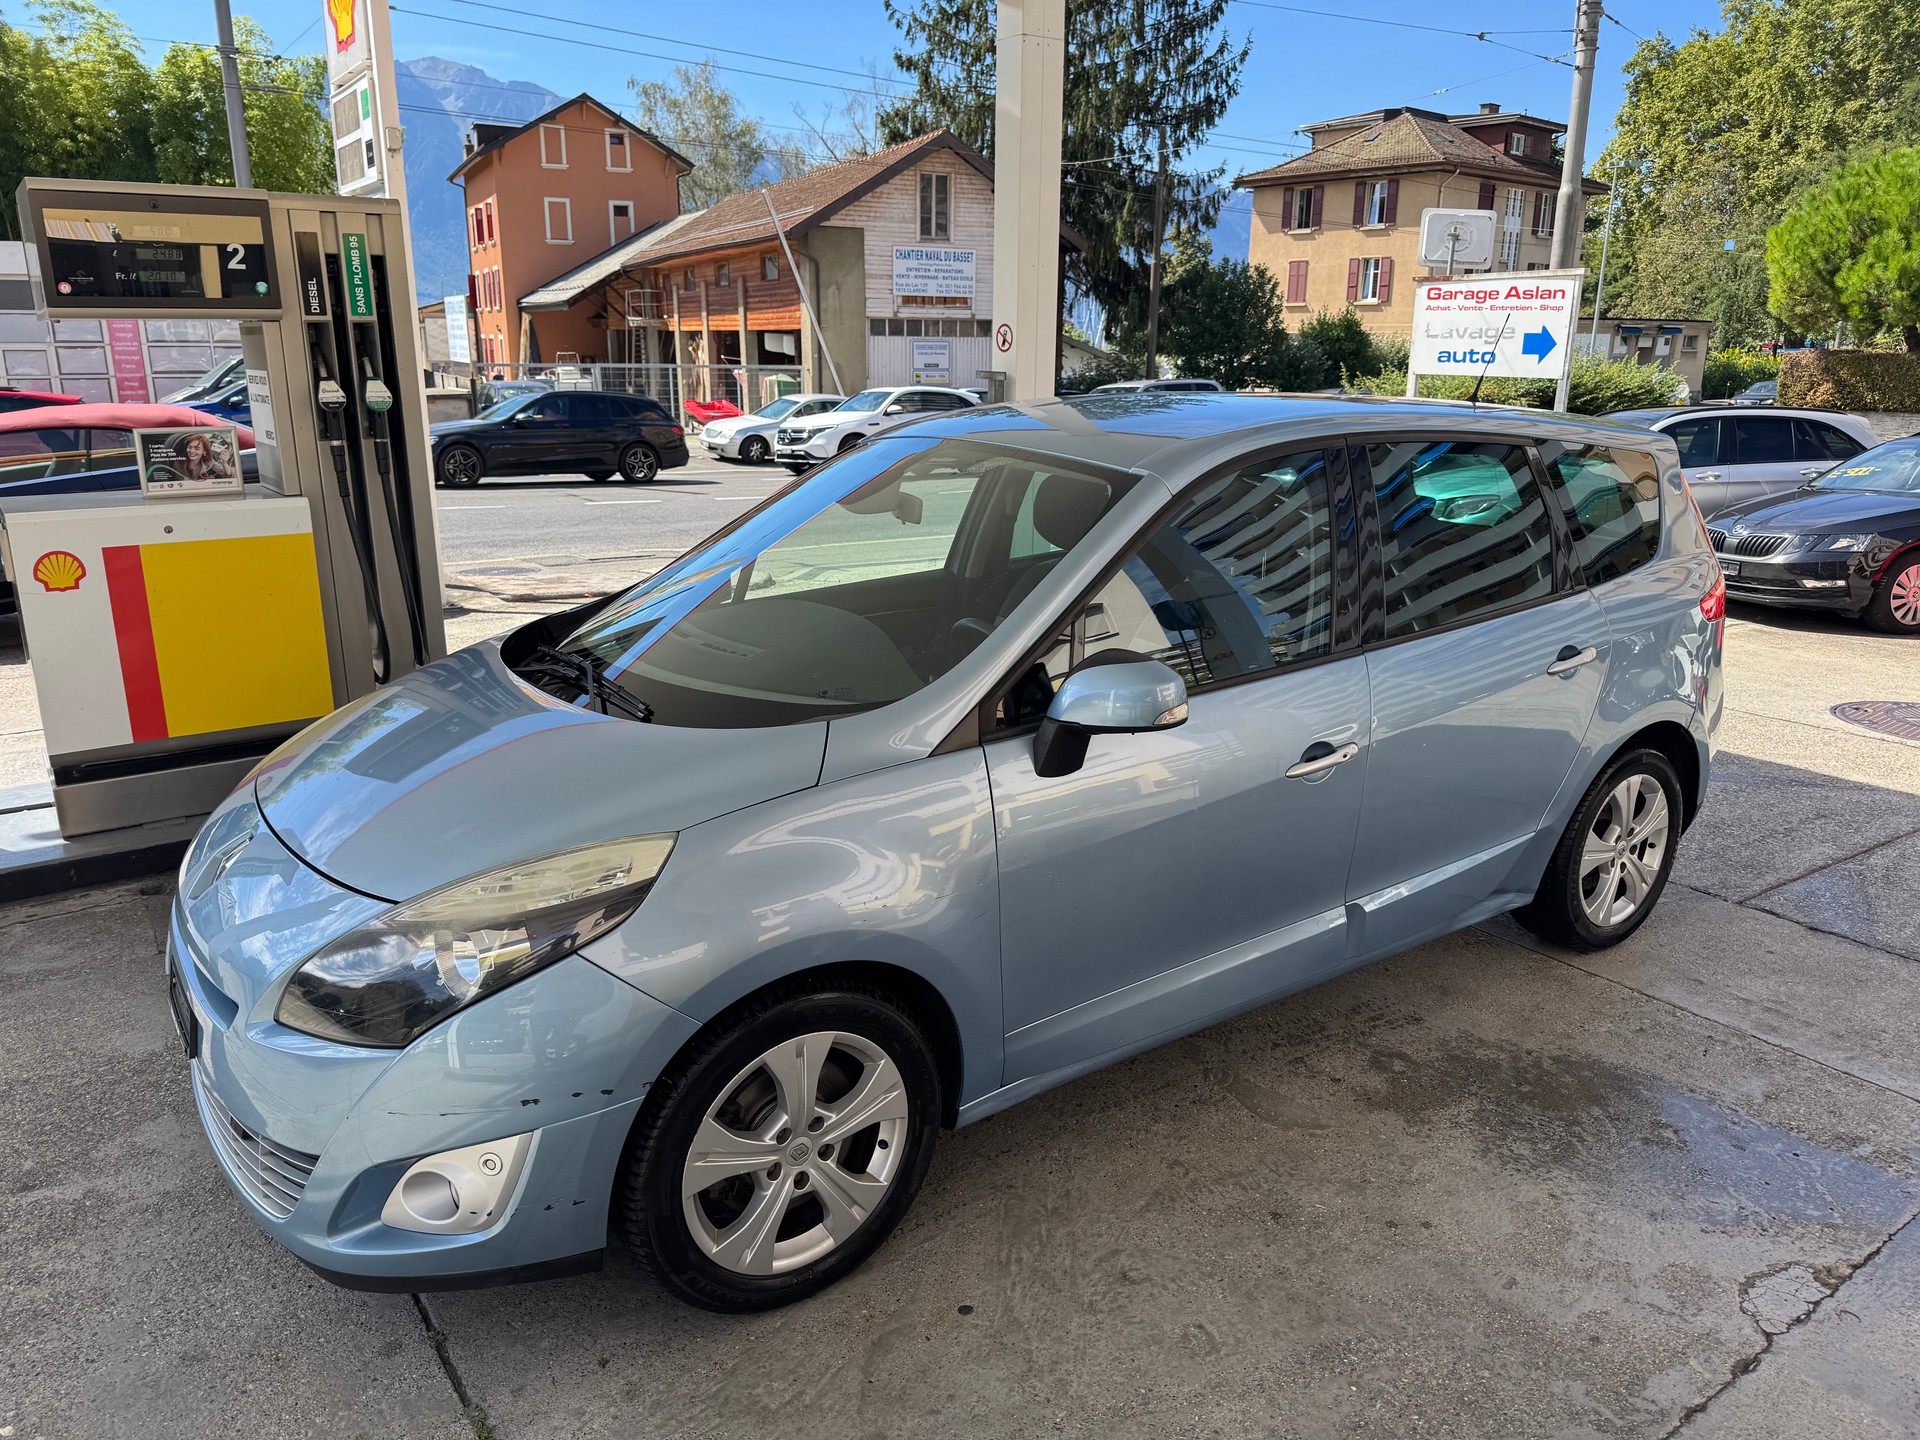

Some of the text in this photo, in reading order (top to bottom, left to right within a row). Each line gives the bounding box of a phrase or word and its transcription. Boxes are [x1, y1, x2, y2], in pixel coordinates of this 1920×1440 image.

[226, 243, 247, 270] 2
[895, 249, 974, 263] CHANTIER NAVAL DU BASSET
[115, 272, 128, 280] Fr.
[349, 236, 366, 313] SANS PLOMB 95
[308, 277, 320, 313] DIESEL
[1427, 286, 1566, 304] Garage Aslan
[1425, 304, 1452, 312] Achat
[1539, 304, 1564, 313] Shop
[1425, 323, 1516, 345] Lavage
[1437, 349, 1496, 364] auto
